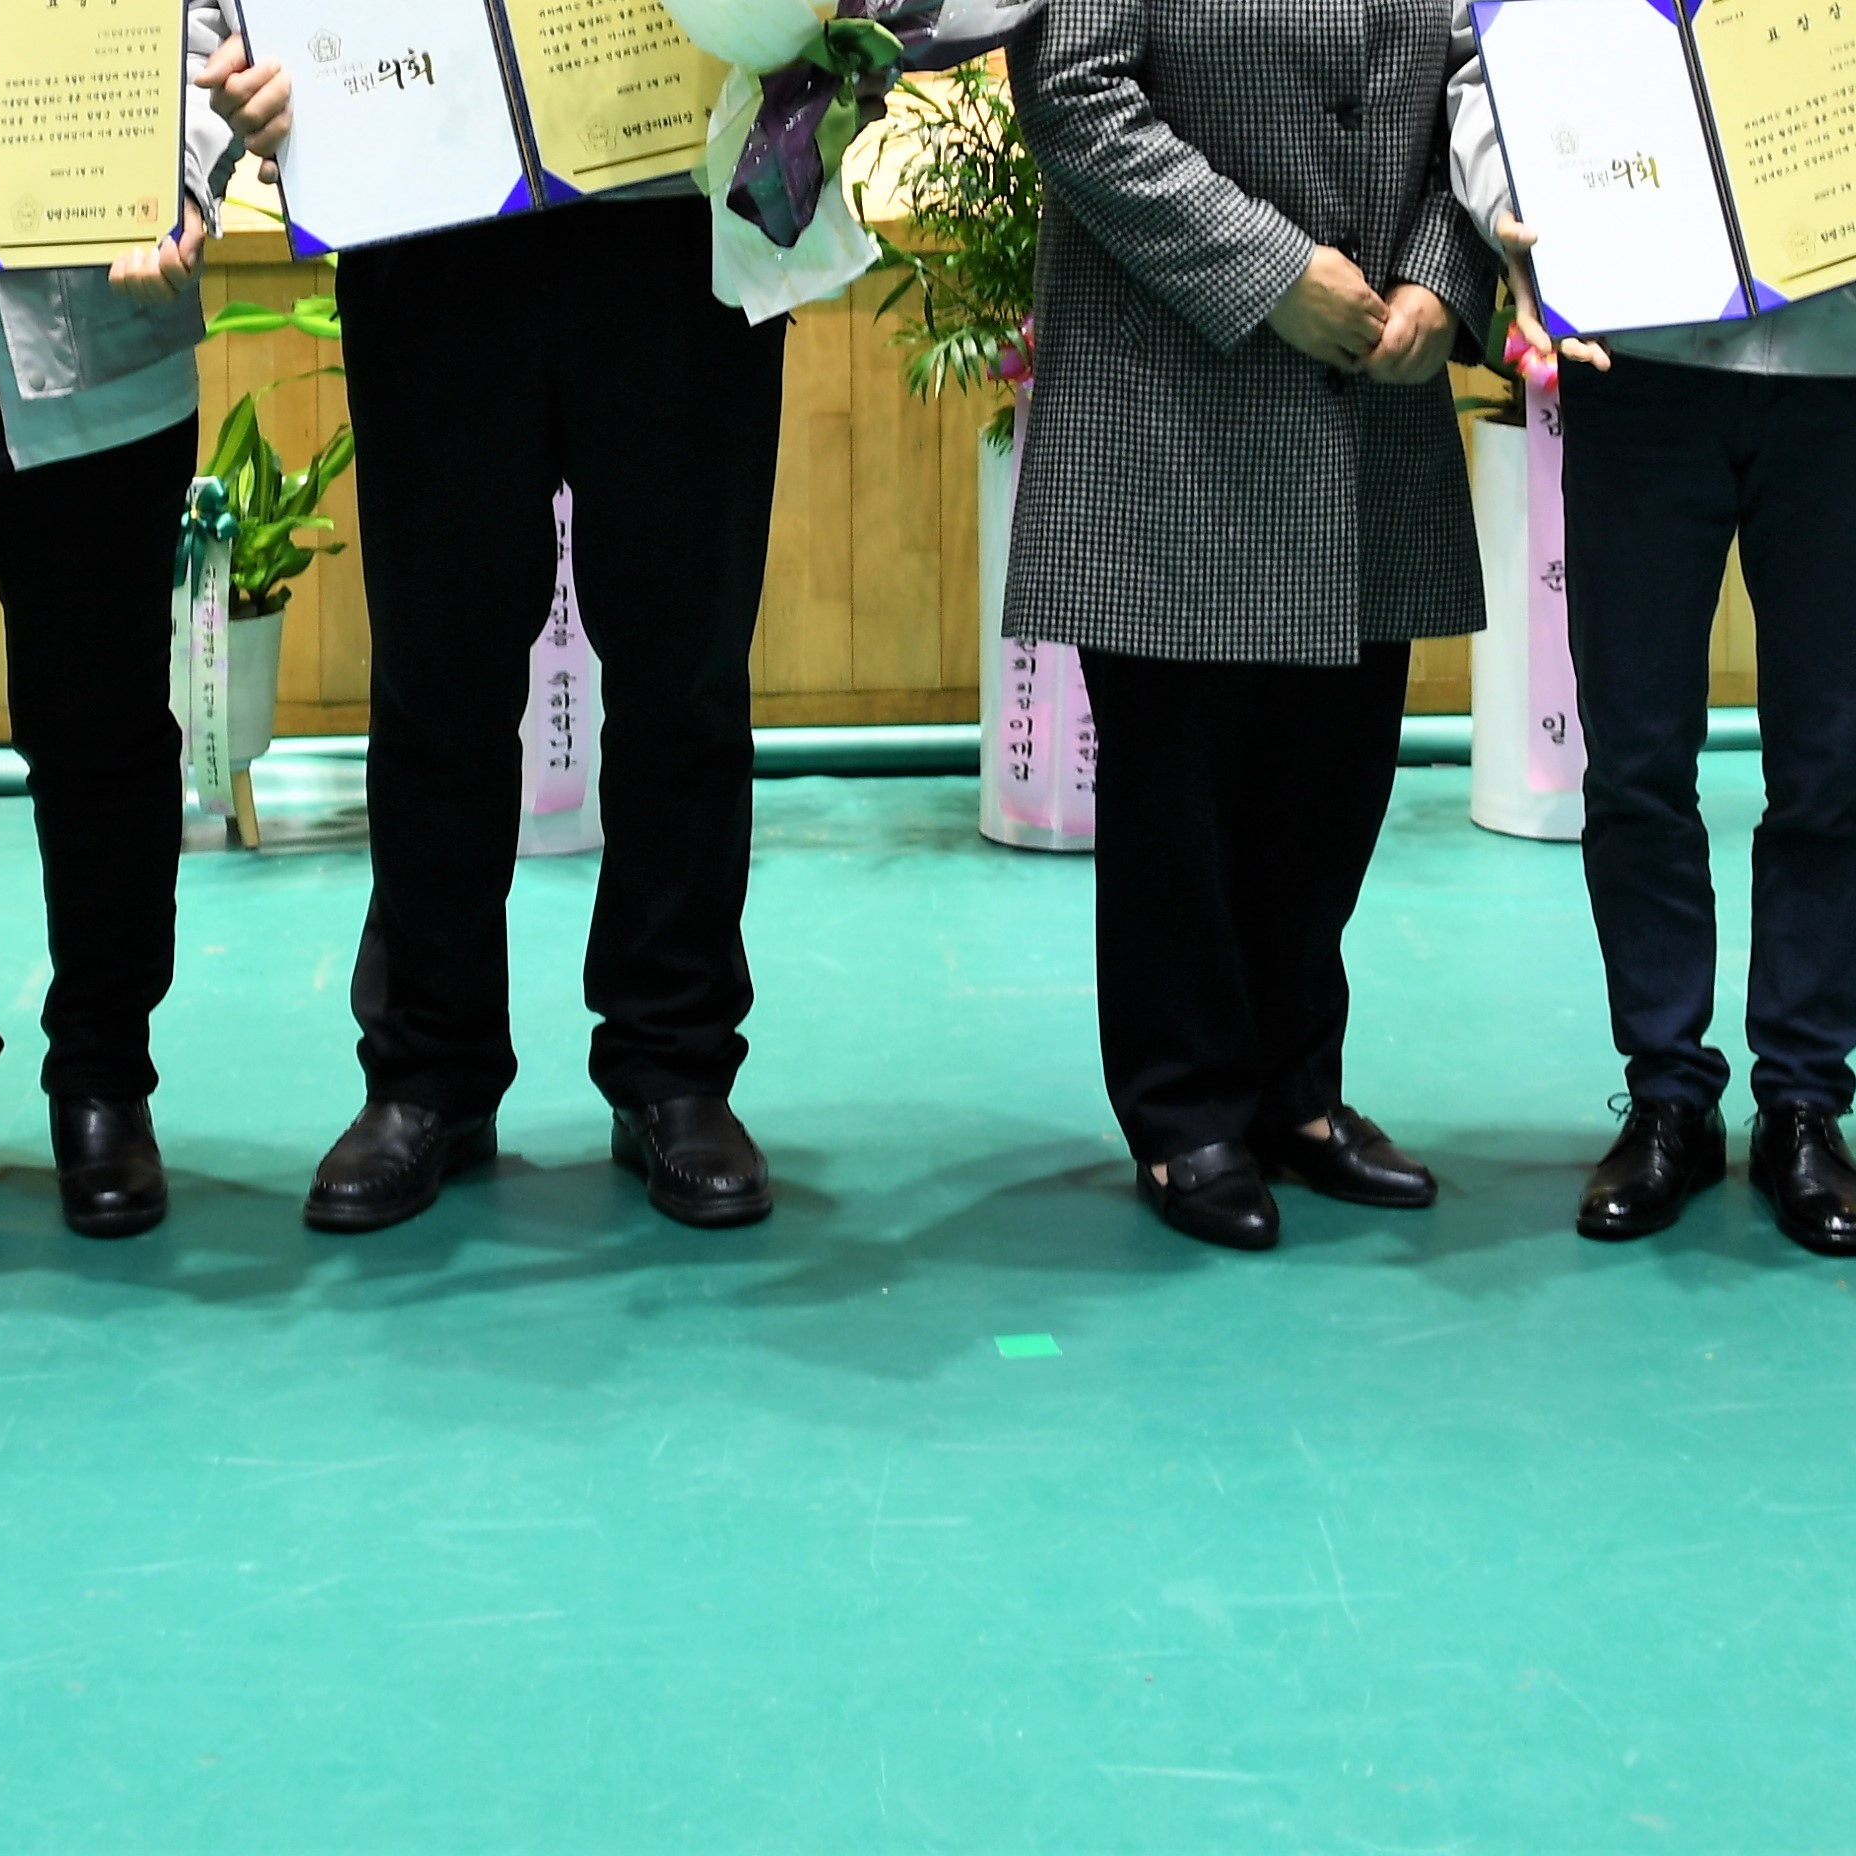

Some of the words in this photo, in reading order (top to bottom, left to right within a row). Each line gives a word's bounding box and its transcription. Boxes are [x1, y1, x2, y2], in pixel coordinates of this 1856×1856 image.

[379, 47, 434, 89] 의회
[1612, 151, 1660, 188] 의회
[547, 670, 577, 772] 축하합니다
